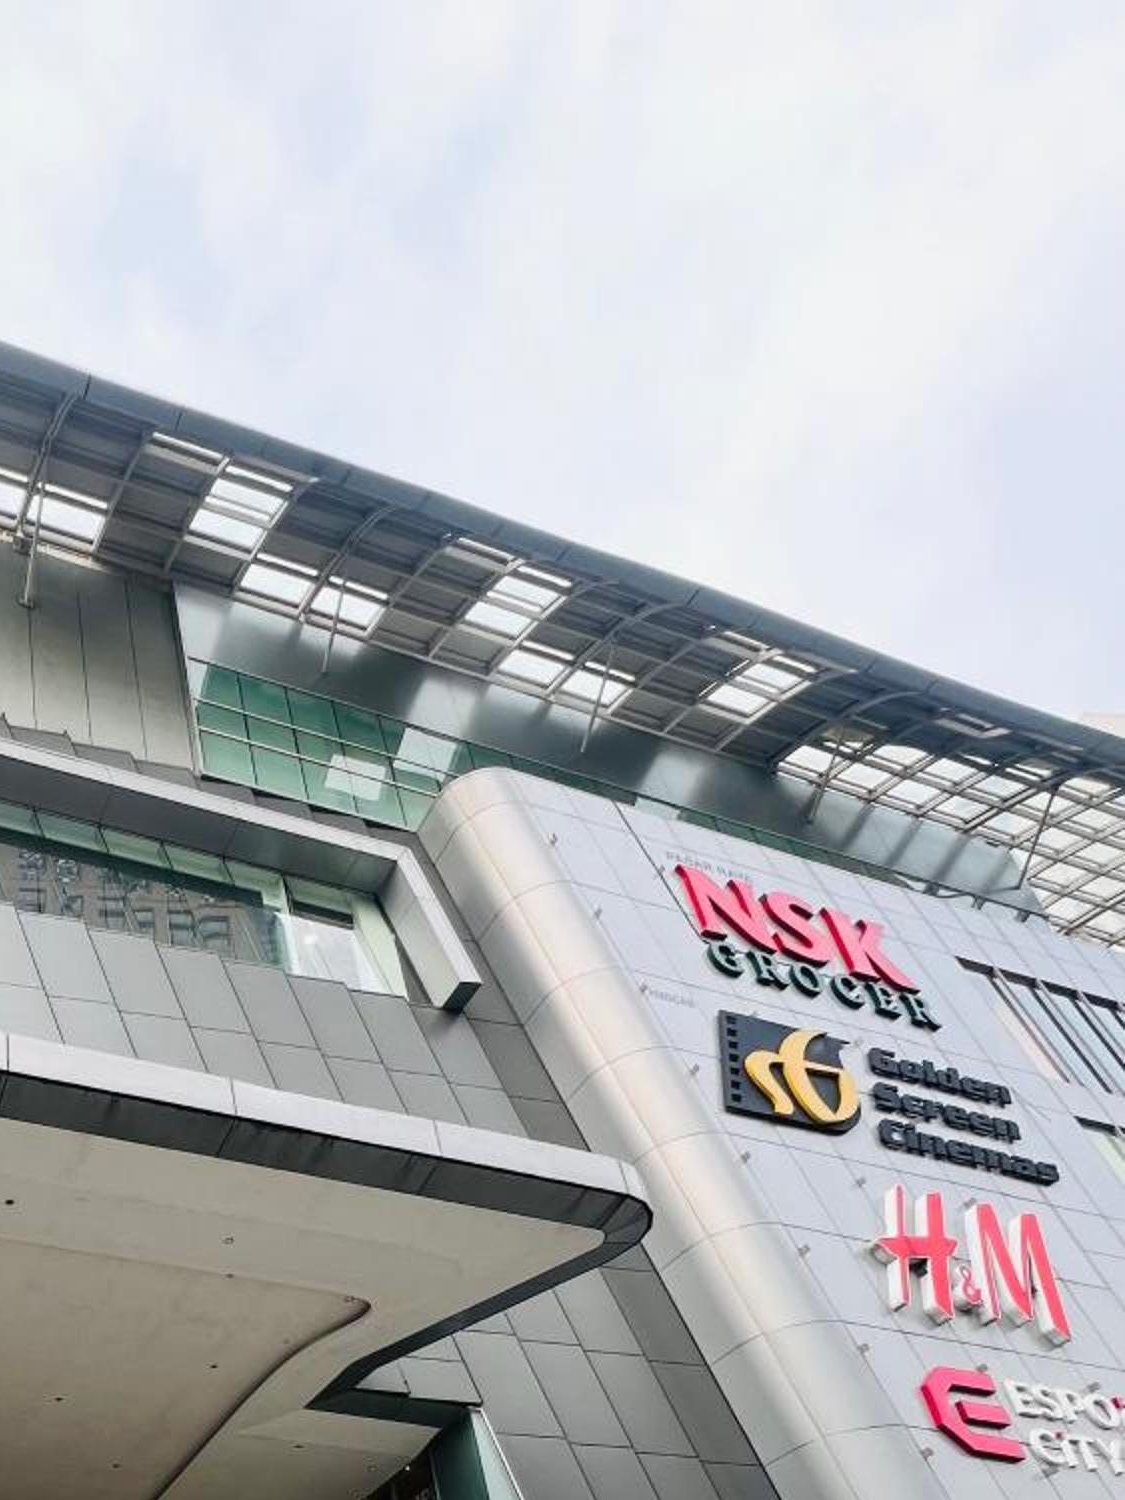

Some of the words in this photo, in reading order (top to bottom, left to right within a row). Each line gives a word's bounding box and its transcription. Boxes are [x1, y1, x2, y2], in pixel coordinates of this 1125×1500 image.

[675, 864, 921, 996] NSK
[706, 939, 943, 1033] GROCER
[868, 1047, 1013, 1107] Golden
[872, 1081, 1023, 1143] Screen
[878, 1118, 1061, 1187] Cinemas
[872, 1184, 1073, 1349] H&M
[1002, 1377, 1125, 1431] ESPO
